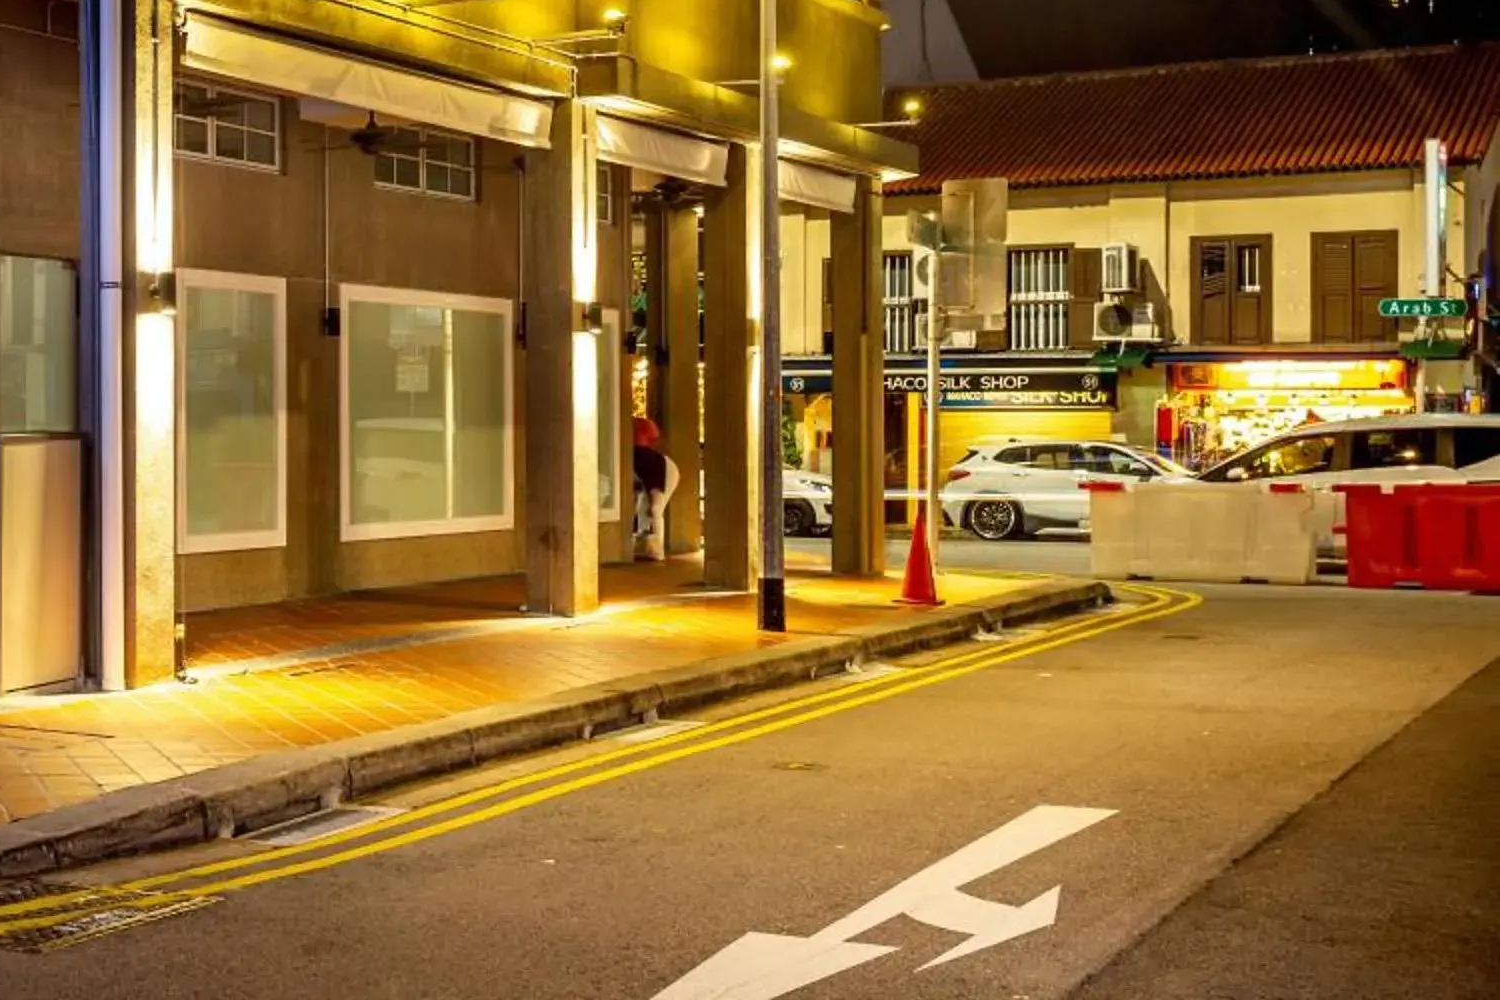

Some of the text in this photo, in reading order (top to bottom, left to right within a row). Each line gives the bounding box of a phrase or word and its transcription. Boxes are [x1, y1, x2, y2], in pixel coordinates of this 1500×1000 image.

[1389, 302, 1457, 314] Arab St
[884, 375, 1029, 391] HACO SILK SHOP
